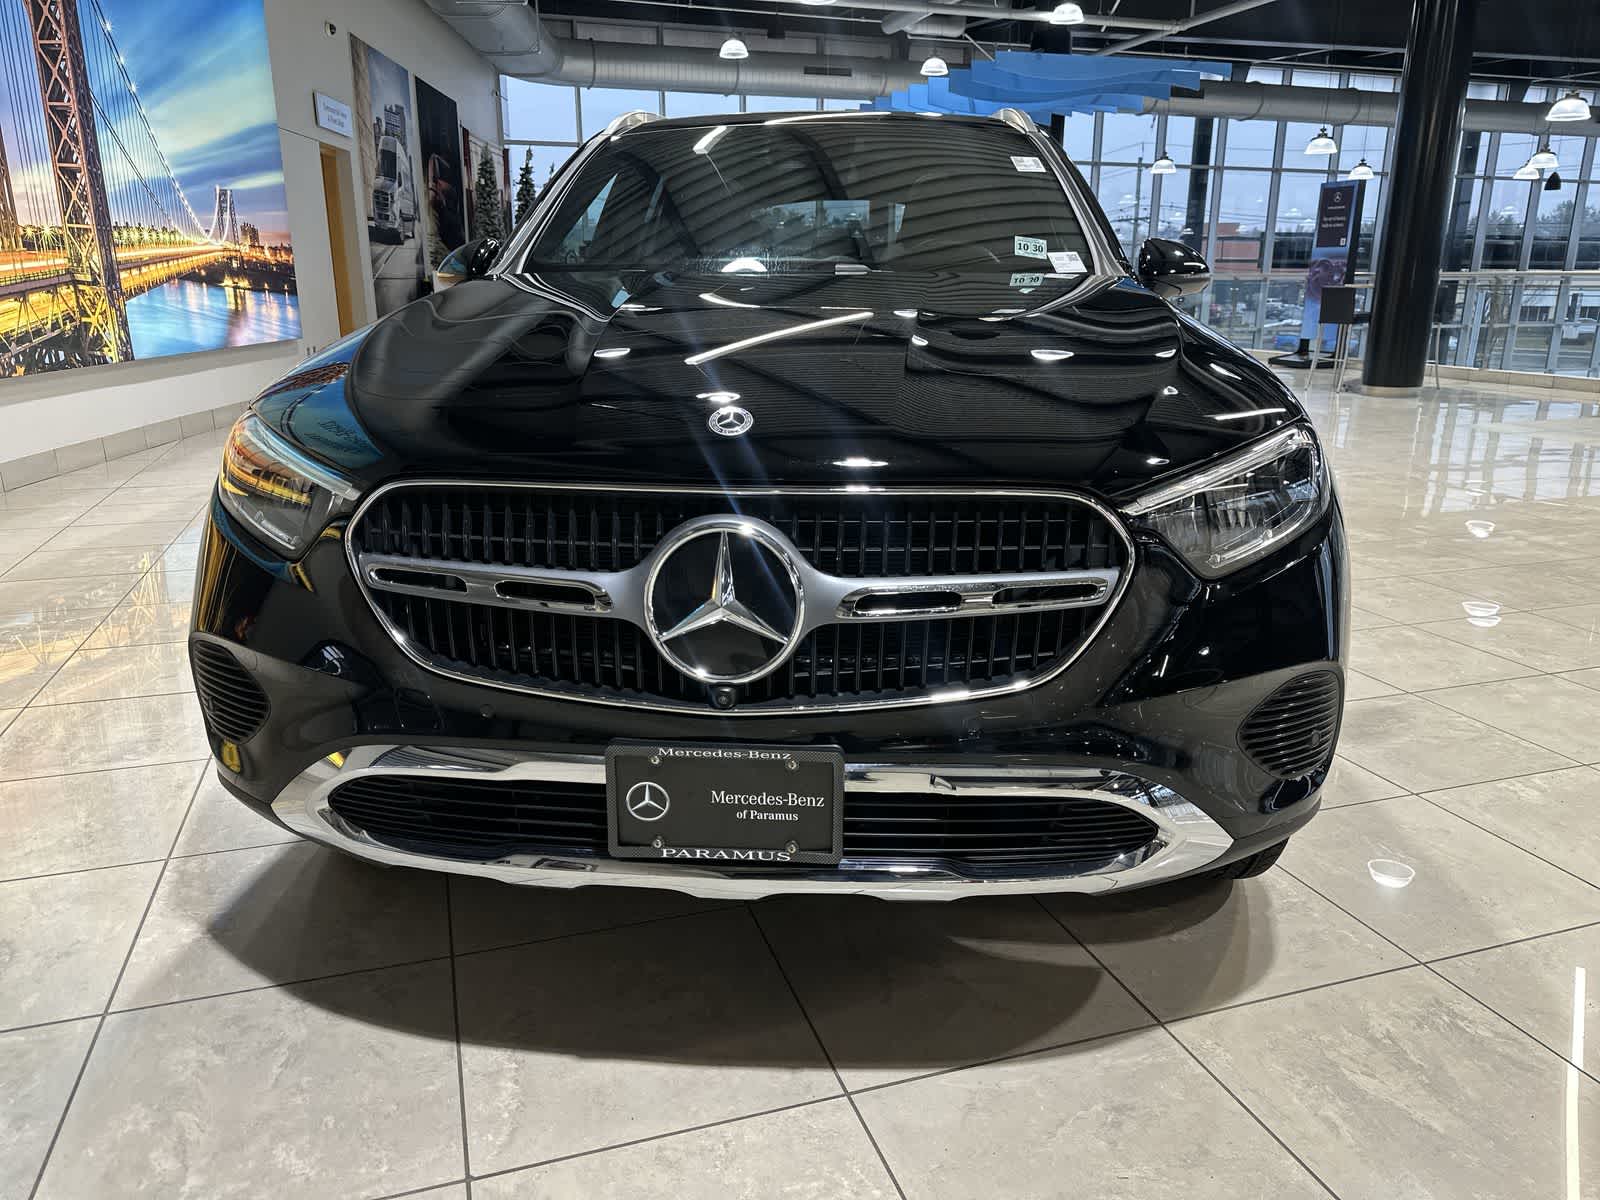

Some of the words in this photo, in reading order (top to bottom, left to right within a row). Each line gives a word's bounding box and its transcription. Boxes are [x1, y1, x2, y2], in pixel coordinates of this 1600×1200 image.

[1018, 242, 1029, 251] 10
[1032, 244, 1044, 253] 30
[658, 747, 792, 760] Mercedes-Benz
[711, 790, 825, 808] Mercedes-Benz
[736, 810, 748, 820] of
[750, 810, 799, 821] Paramus
[661, 848, 792, 862] PARAMUS
